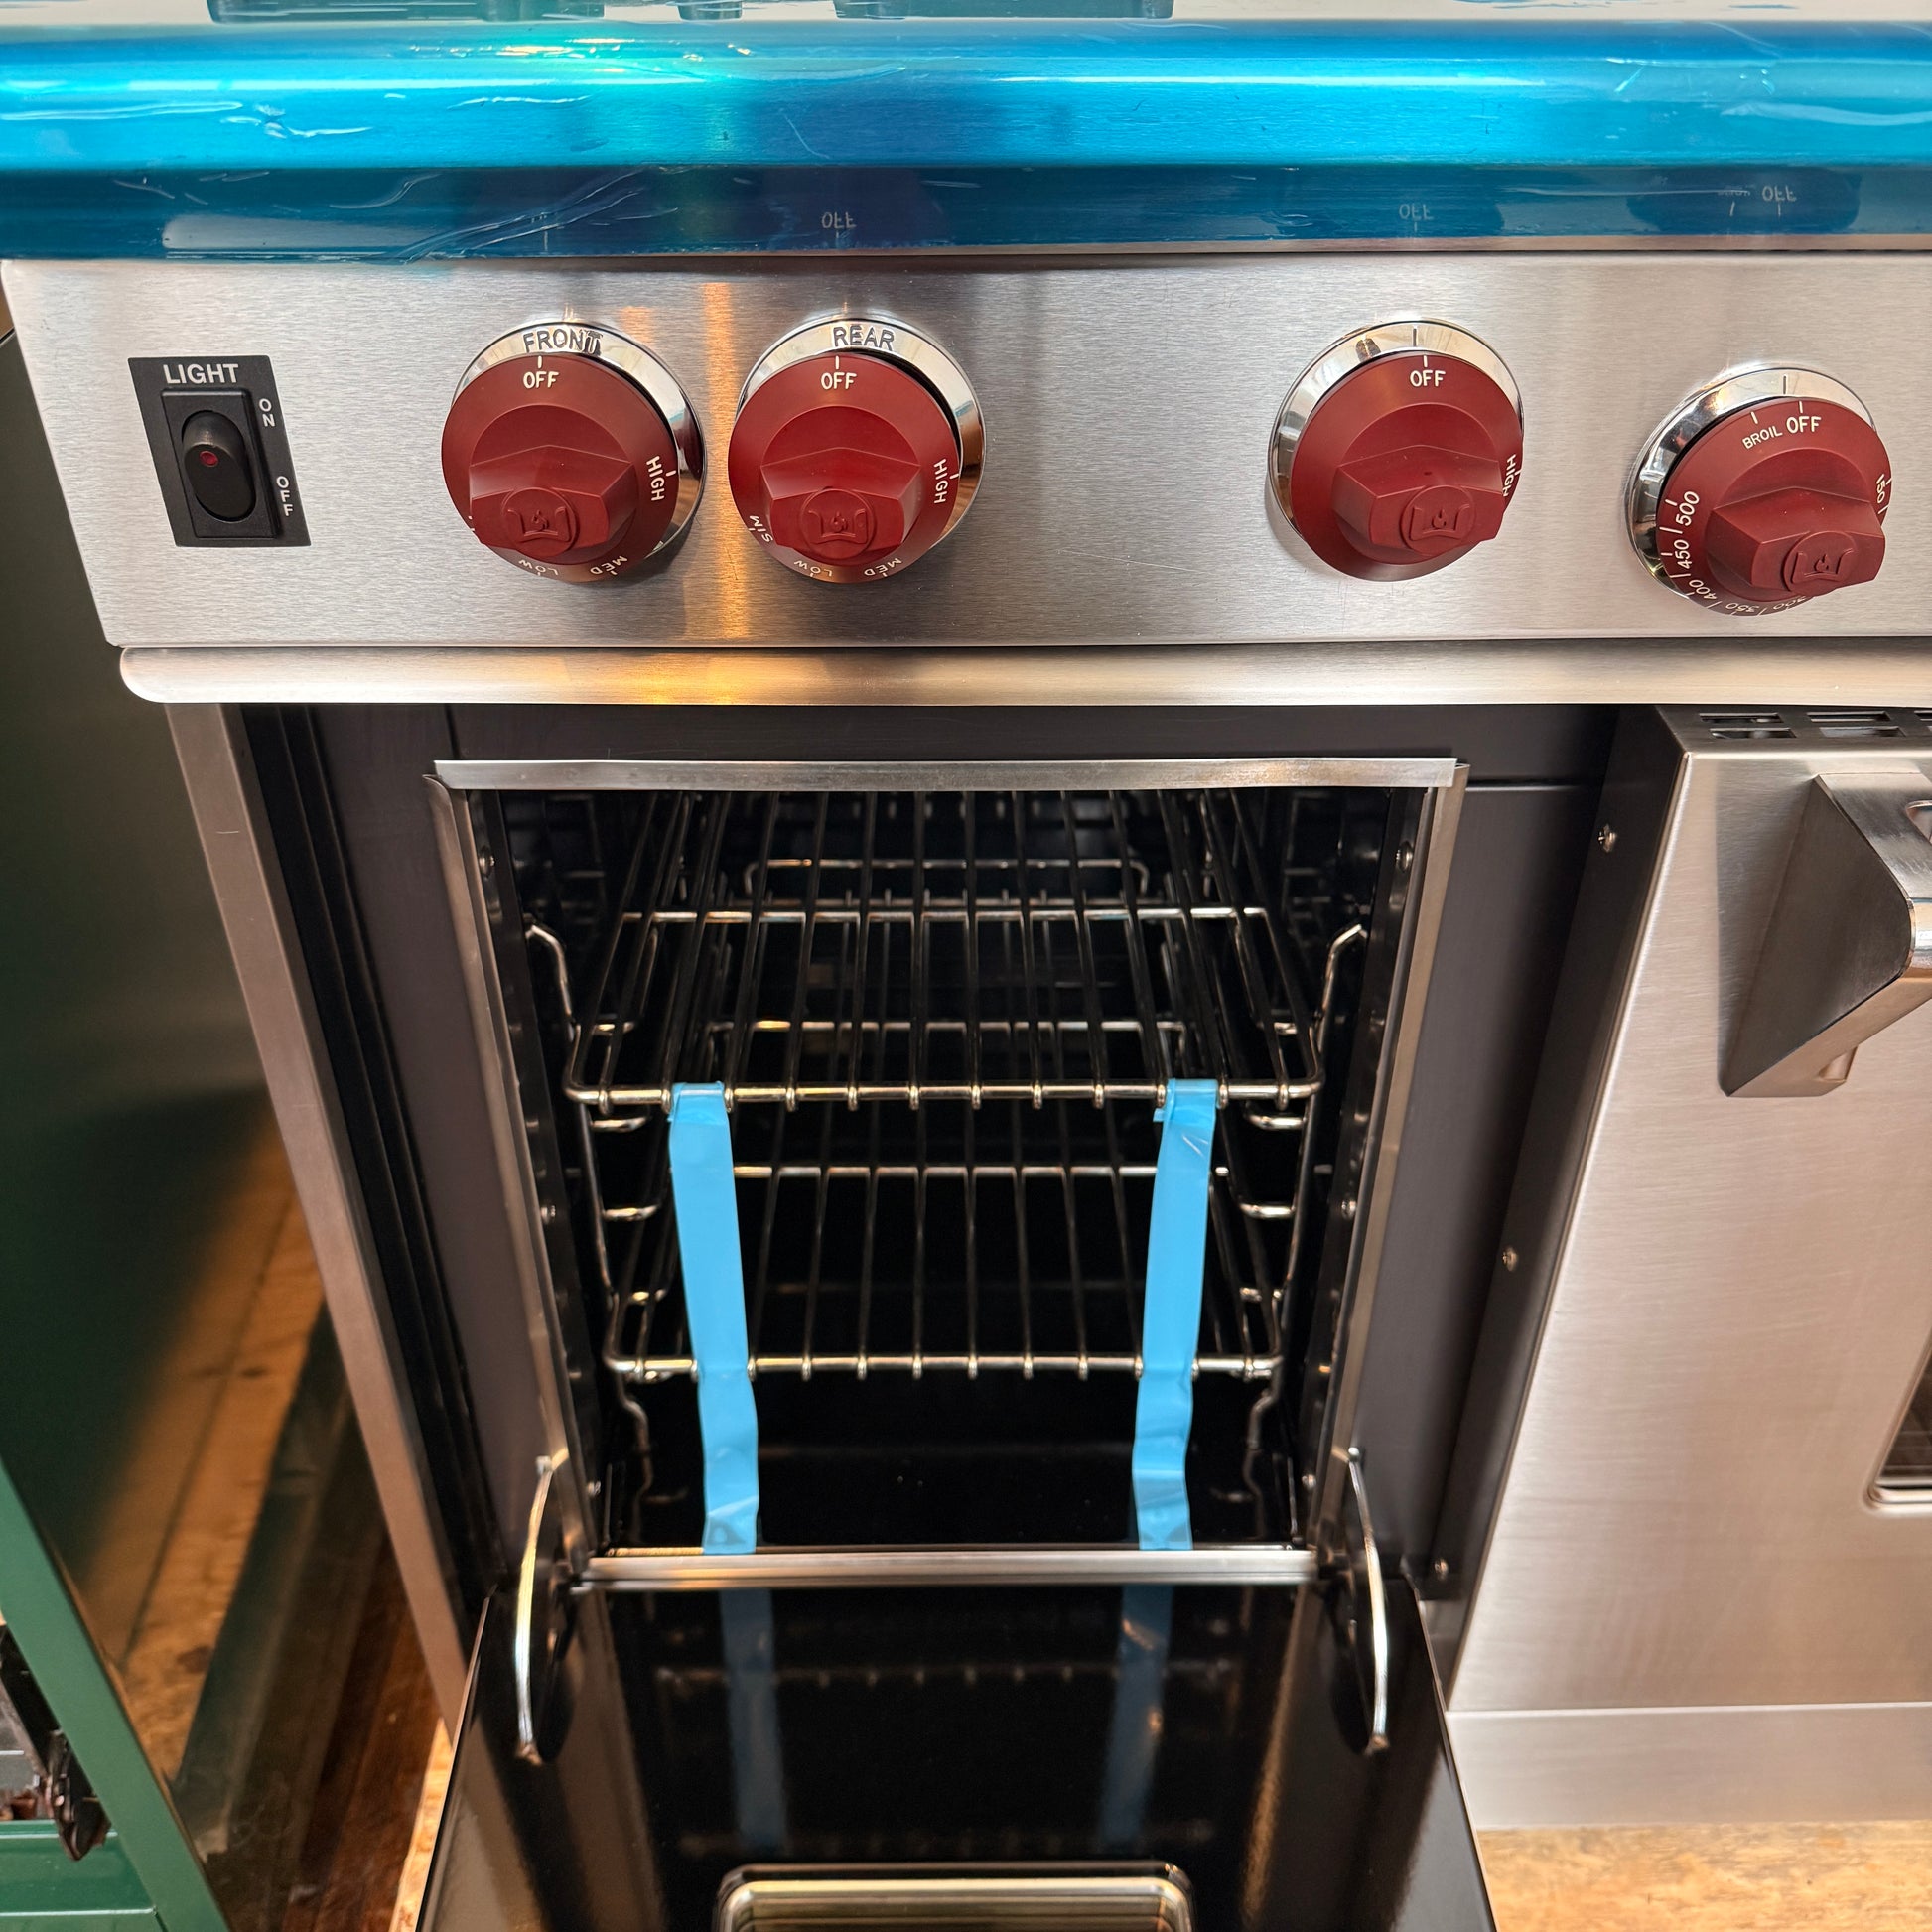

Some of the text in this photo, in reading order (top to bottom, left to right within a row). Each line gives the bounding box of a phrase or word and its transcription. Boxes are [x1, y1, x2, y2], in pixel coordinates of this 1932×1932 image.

[523, 328, 603, 356] FRONT
[832, 324, 895, 351] REAR
[163, 363, 239, 385] LIGHT
[522, 371, 560, 389] OFF
[820, 372, 858, 390] OFF
[1410, 369, 1447, 387] OFF
[258, 398, 276, 427] ON
[1786, 415, 1822, 434] OFF
[1742, 425, 1783, 449] BROIL
[646, 455, 665, 501] HIGH
[933, 458, 949, 504] HIGH
[1502, 454, 1517, 497] HIGH
[276, 476, 294, 517] OFF
[1876, 474, 1886, 503] 150
[1675, 490, 1701, 526] 500
[749, 515, 774, 543] SIM
[590, 555, 628, 575] MED
[1673, 539, 1693, 569] 450
[518, 559, 559, 576] LOW
[794, 560, 833, 577] LOW
[864, 558, 902, 576] MED
[1689, 579, 1718, 600] 400
